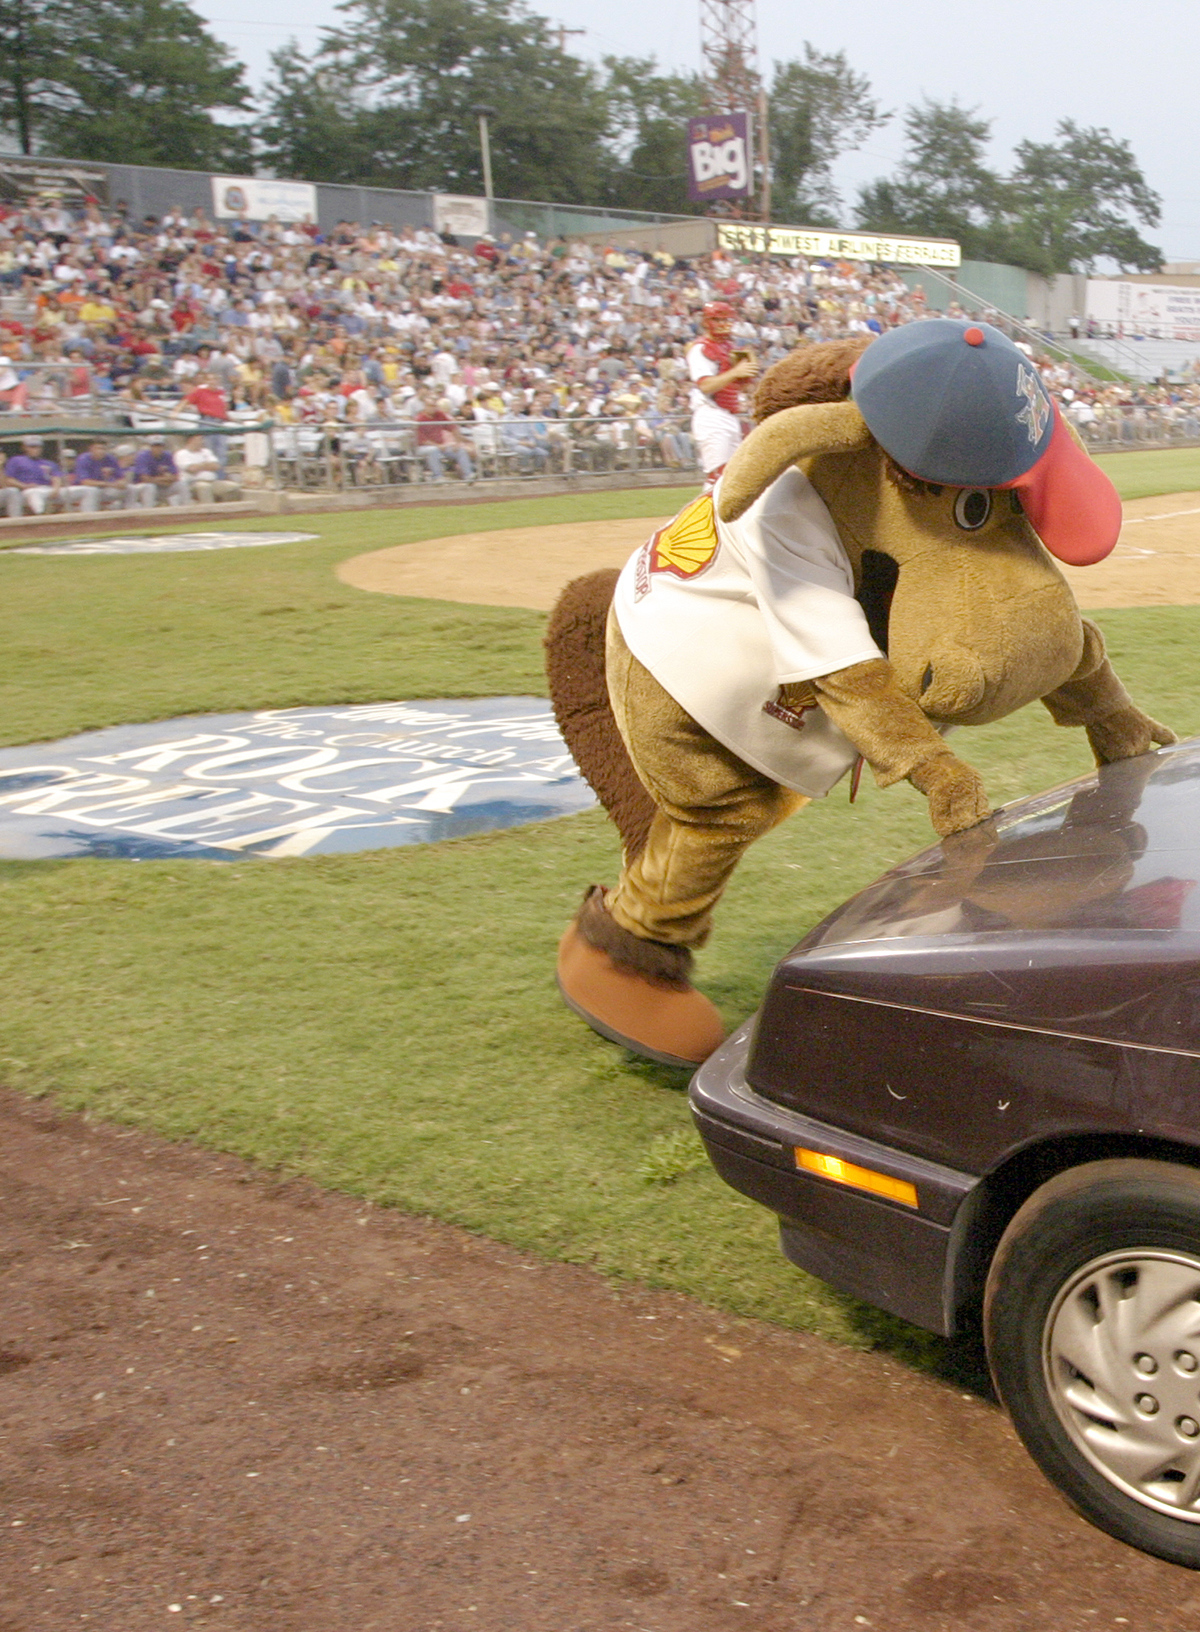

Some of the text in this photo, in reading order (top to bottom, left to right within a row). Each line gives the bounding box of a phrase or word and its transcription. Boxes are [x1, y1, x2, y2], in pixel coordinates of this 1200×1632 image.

[828, 238, 894, 257] AIRLINES
[897, 245, 956, 263] TERRACE
[223, 720, 325, 740] The
[323, 732, 517, 766] Church
[77, 734, 560, 814] ROCK
